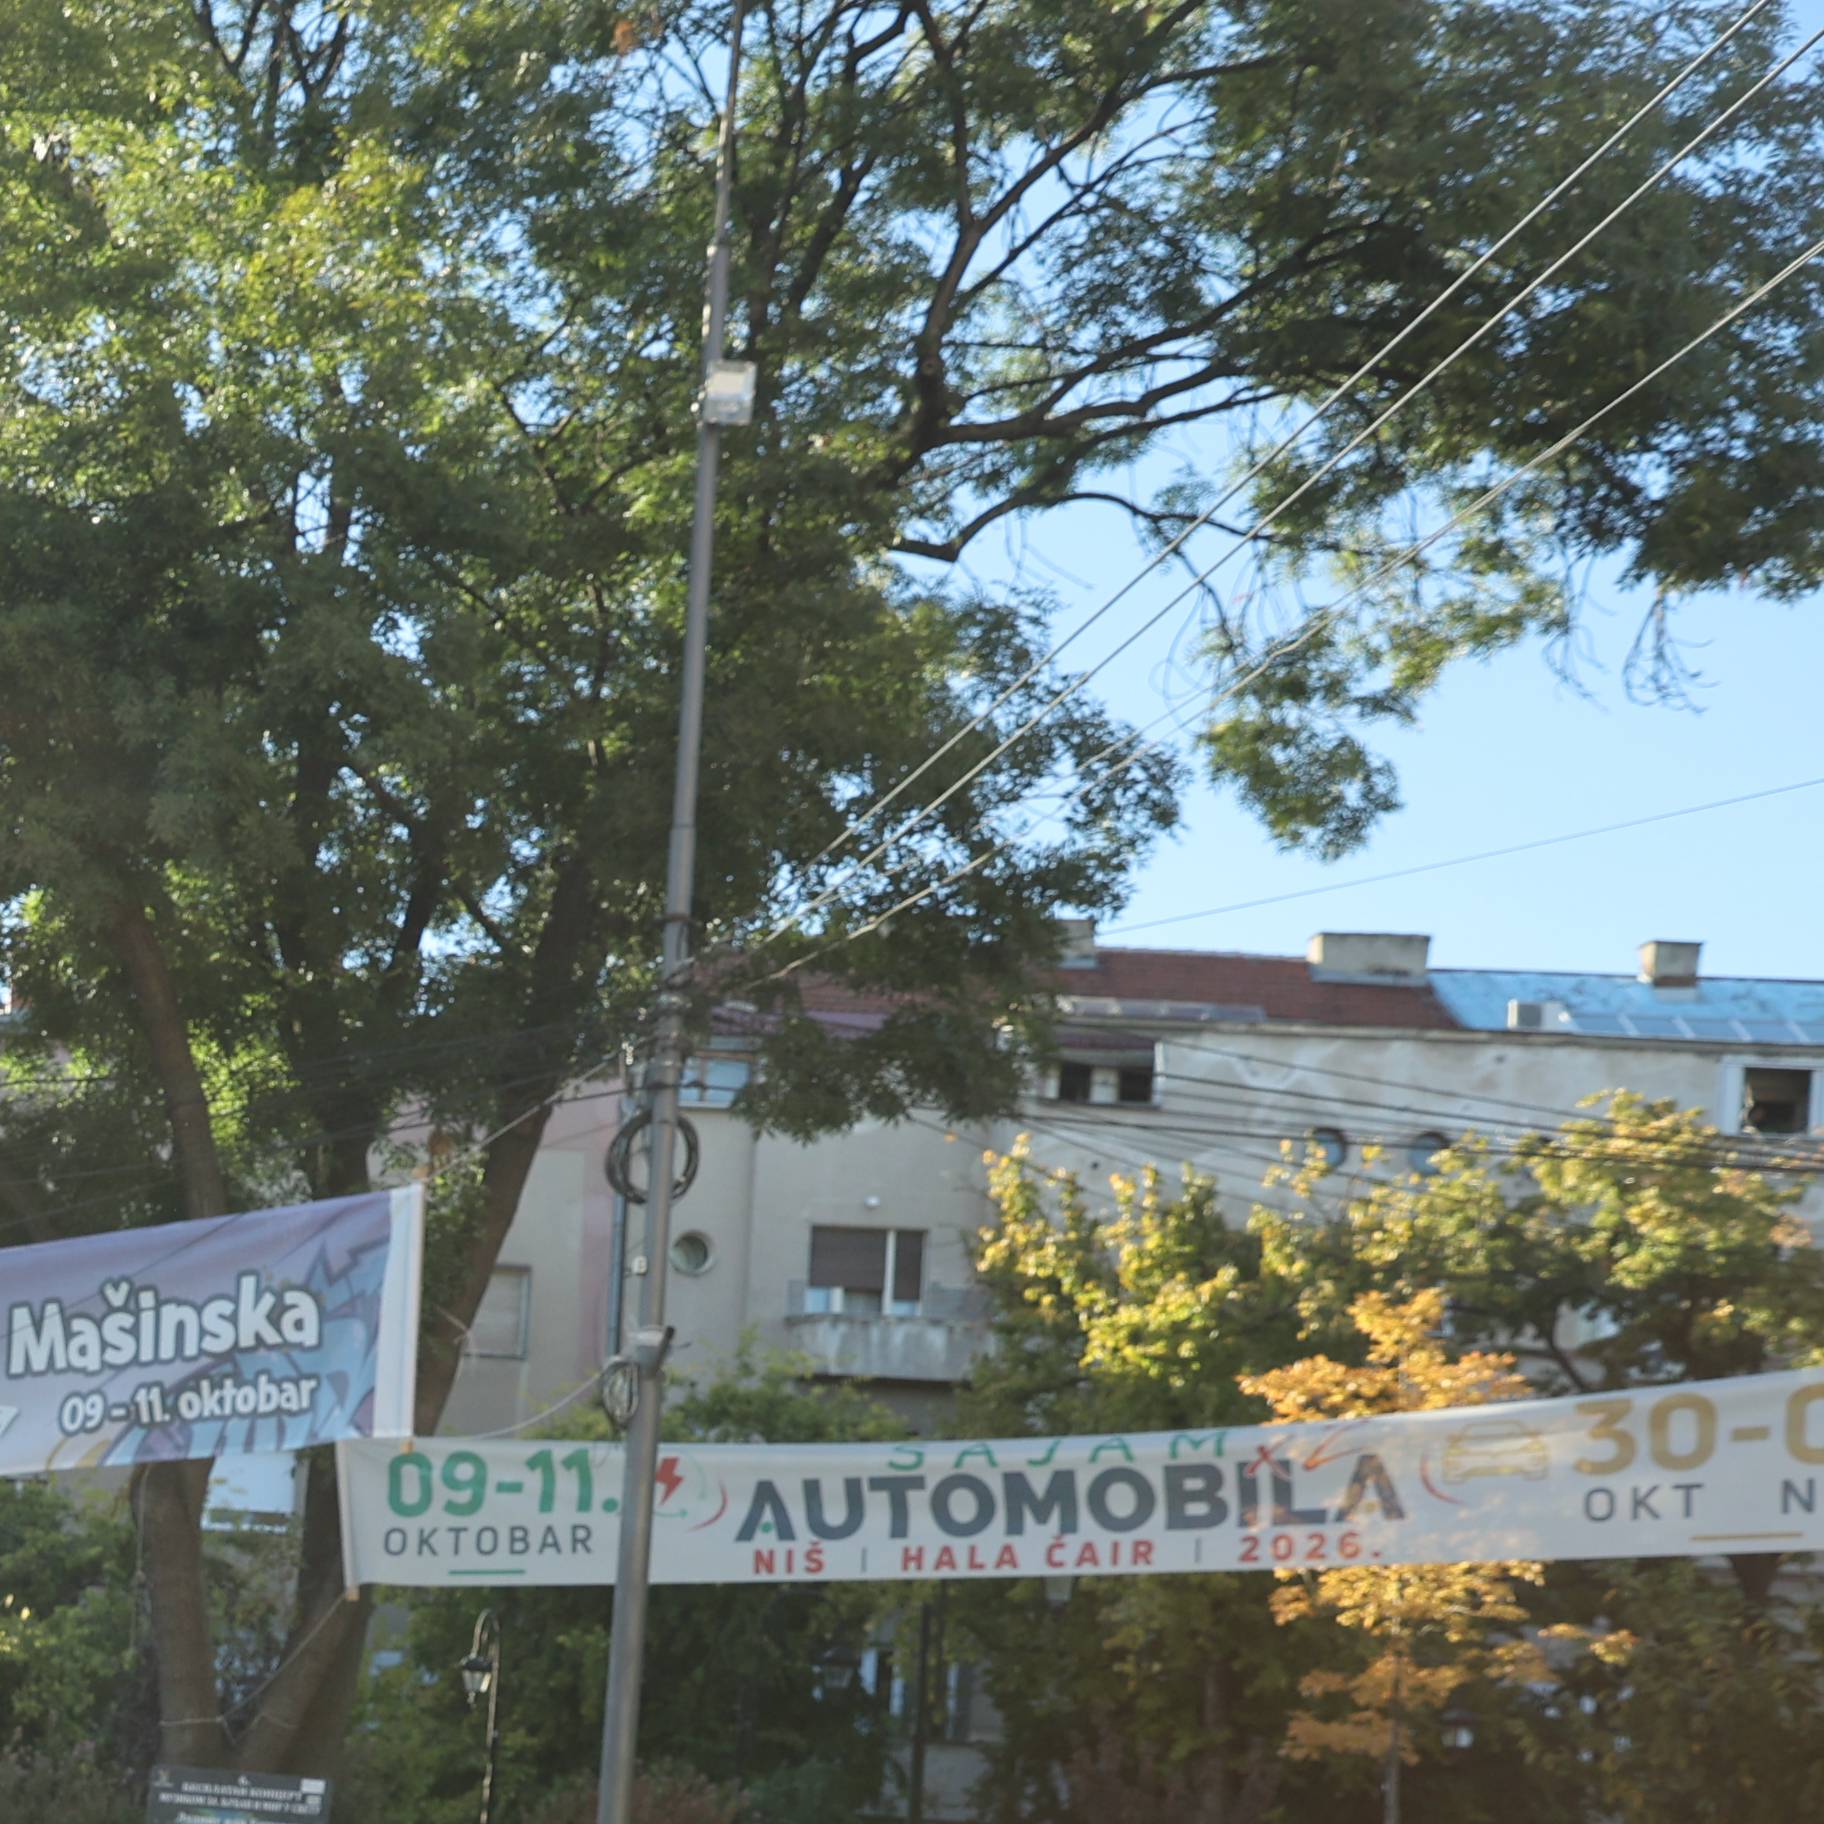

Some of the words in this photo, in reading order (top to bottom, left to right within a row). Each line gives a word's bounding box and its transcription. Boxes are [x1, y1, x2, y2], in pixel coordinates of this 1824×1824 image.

[9, 1274, 320, 1375] Mašinska
[61, 1396, 98, 1431] 09
[135, 1386, 170, 1424] 11.
[178, 1371, 317, 1421] oktobar
[886, 1428, 1230, 1472] SAJAM
[386, 1449, 620, 1518] 09-11.
[733, 1453, 1405, 1542] AUTOMOBILA
[1582, 1483, 1704, 1522] OKT
[383, 1525, 593, 1556] OKTOBAR
[754, 1540, 826, 1575] NIŠ
[901, 1544, 1019, 1572] HALA
[1046, 1536, 1156, 1569] ČAIR
